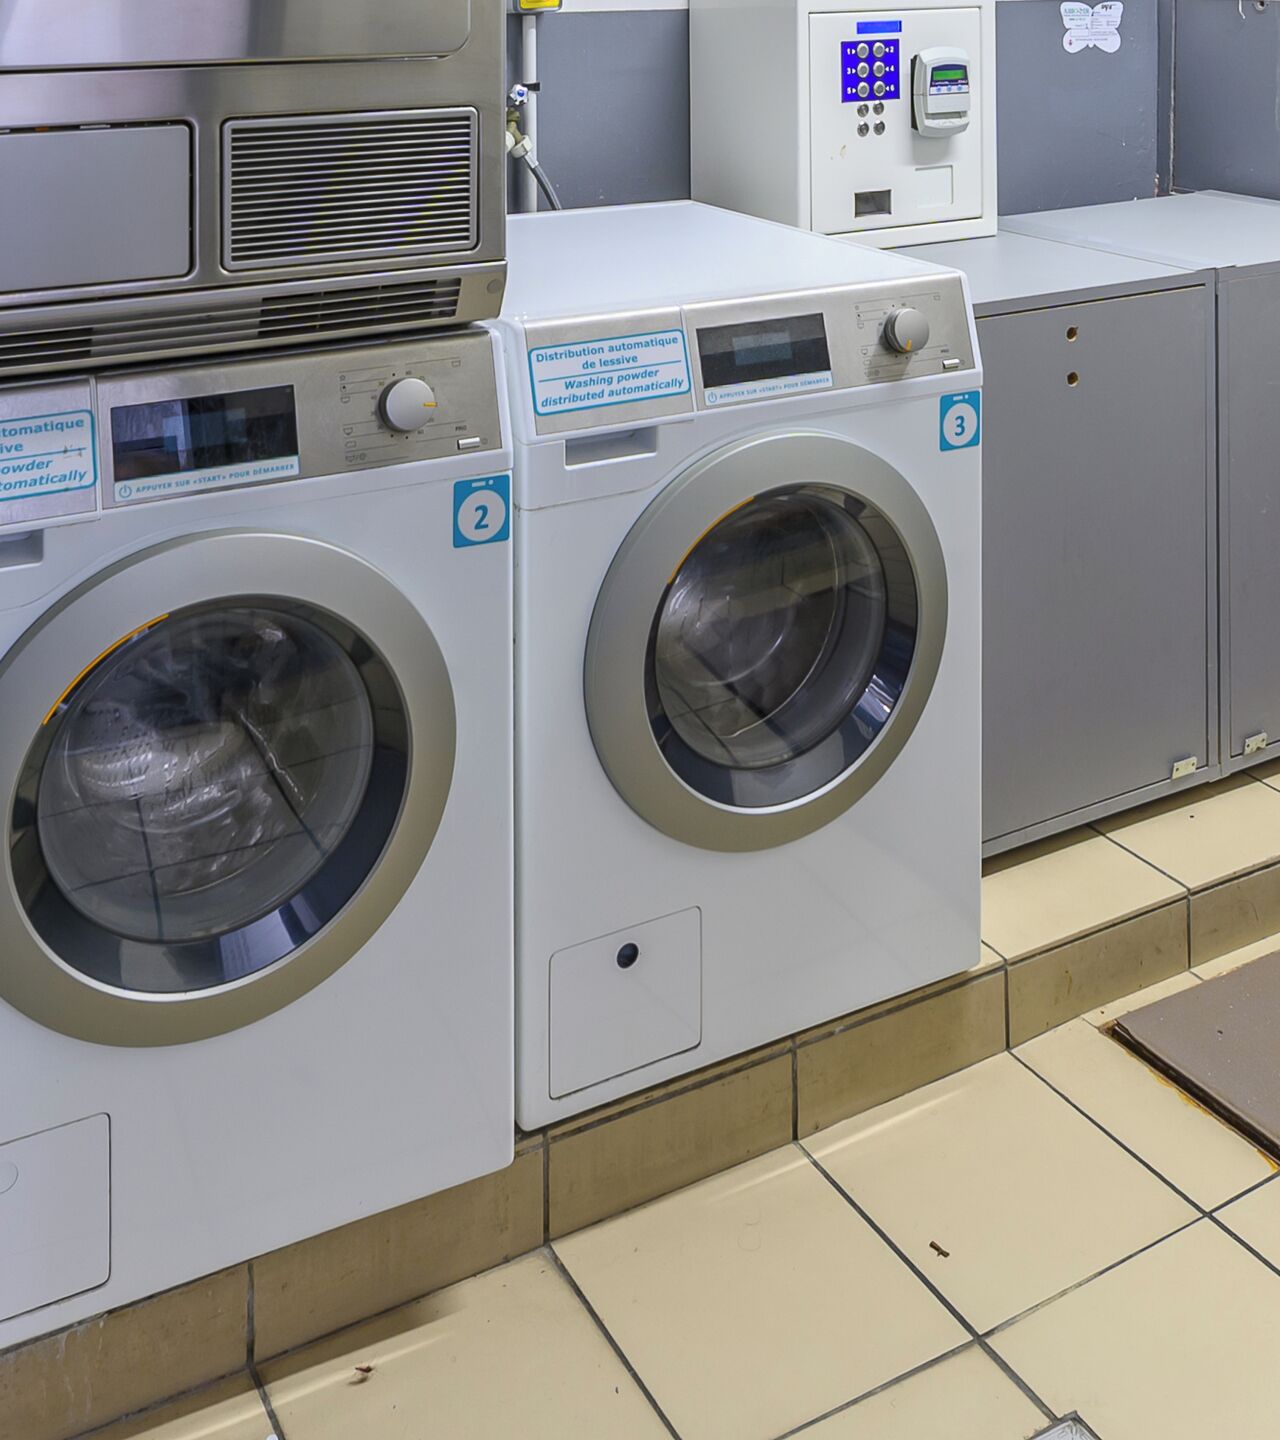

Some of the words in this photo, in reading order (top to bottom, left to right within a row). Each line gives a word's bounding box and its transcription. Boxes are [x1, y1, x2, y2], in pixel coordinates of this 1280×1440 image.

[536, 348, 604, 363] Distribution
[608, 336, 678, 353] automatique
[582, 360, 596, 370] de
[599, 355, 638, 368] lessive
[564, 376, 613, 390] Washing
[617, 368, 659, 383] powder
[541, 390, 605, 408] distributed
[608, 378, 684, 397] automatically
[955, 416, 965, 436] 3
[136, 482, 172, 493] APPUYER
[175, 479, 190, 487] SUR
[229, 471, 250, 480] POUR
[475, 505, 488, 530] 2
